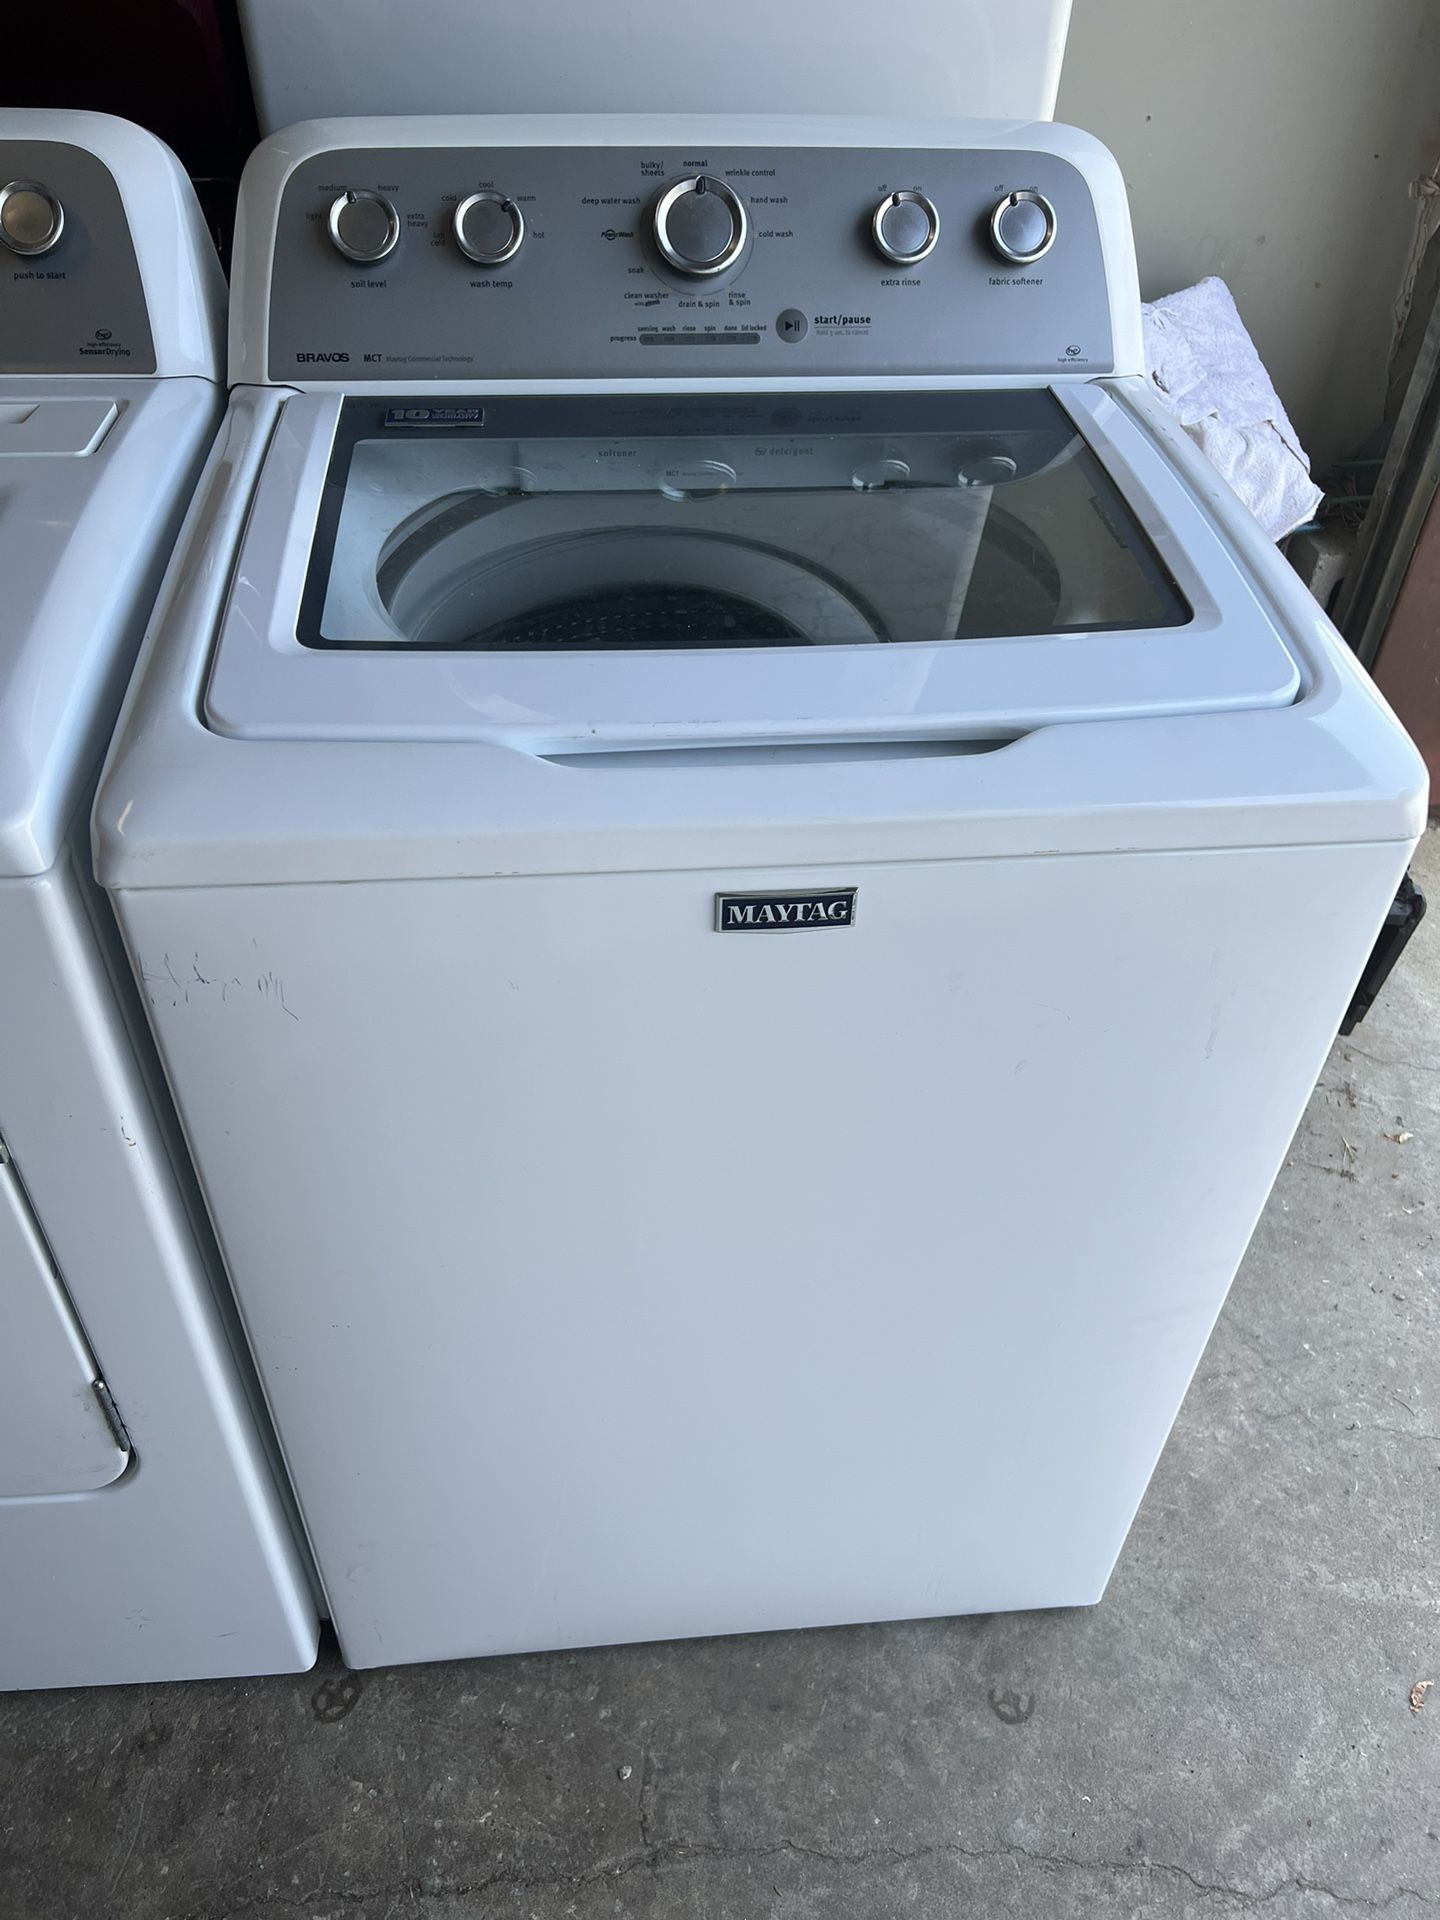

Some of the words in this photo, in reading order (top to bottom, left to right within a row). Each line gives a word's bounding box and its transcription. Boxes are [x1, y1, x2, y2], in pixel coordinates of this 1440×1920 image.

[641, 161, 664, 170] bulky/
[725, 169, 751, 177] wrinkle
[751, 169, 776, 177] control
[378, 184, 399, 193] heavy
[878, 184, 888, 192] off
[994, 184, 1004, 192] off
[441, 194, 457, 202] cold
[581, 197, 600, 206] deep
[622, 197, 641, 205] wash
[408, 220, 429, 228] heavy
[758, 230, 774, 238] cold
[775, 230, 793, 238] wash
[628, 266, 645, 274] soak
[14, 272, 34, 280] push
[36, 272, 45, 280] to
[46, 272, 66, 280] start
[351, 280, 366, 288] soil
[367, 280, 387, 288] level
[470, 280, 490, 288] wash
[492, 280, 513, 290] temp
[881, 278, 900, 286] extra
[901, 278, 921, 286] rinse
[988, 277, 1011, 286] fabric
[1012, 277, 1044, 286] softener
[624, 291, 643, 299] clean
[728, 291, 746, 299] rinse
[678, 300, 697, 308] drain
[704, 300, 720, 310] spin
[735, 299, 751, 308] spin
[814, 314, 871, 326] start/pause
[610, 335, 637, 343] progress
[296, 353, 350, 363] BRAVOS
[363, 354, 382, 363] MCT
[391, 409, 430, 419] 10
[598, 449, 637, 457] softener
[727, 900, 849, 925] MAYTAG
